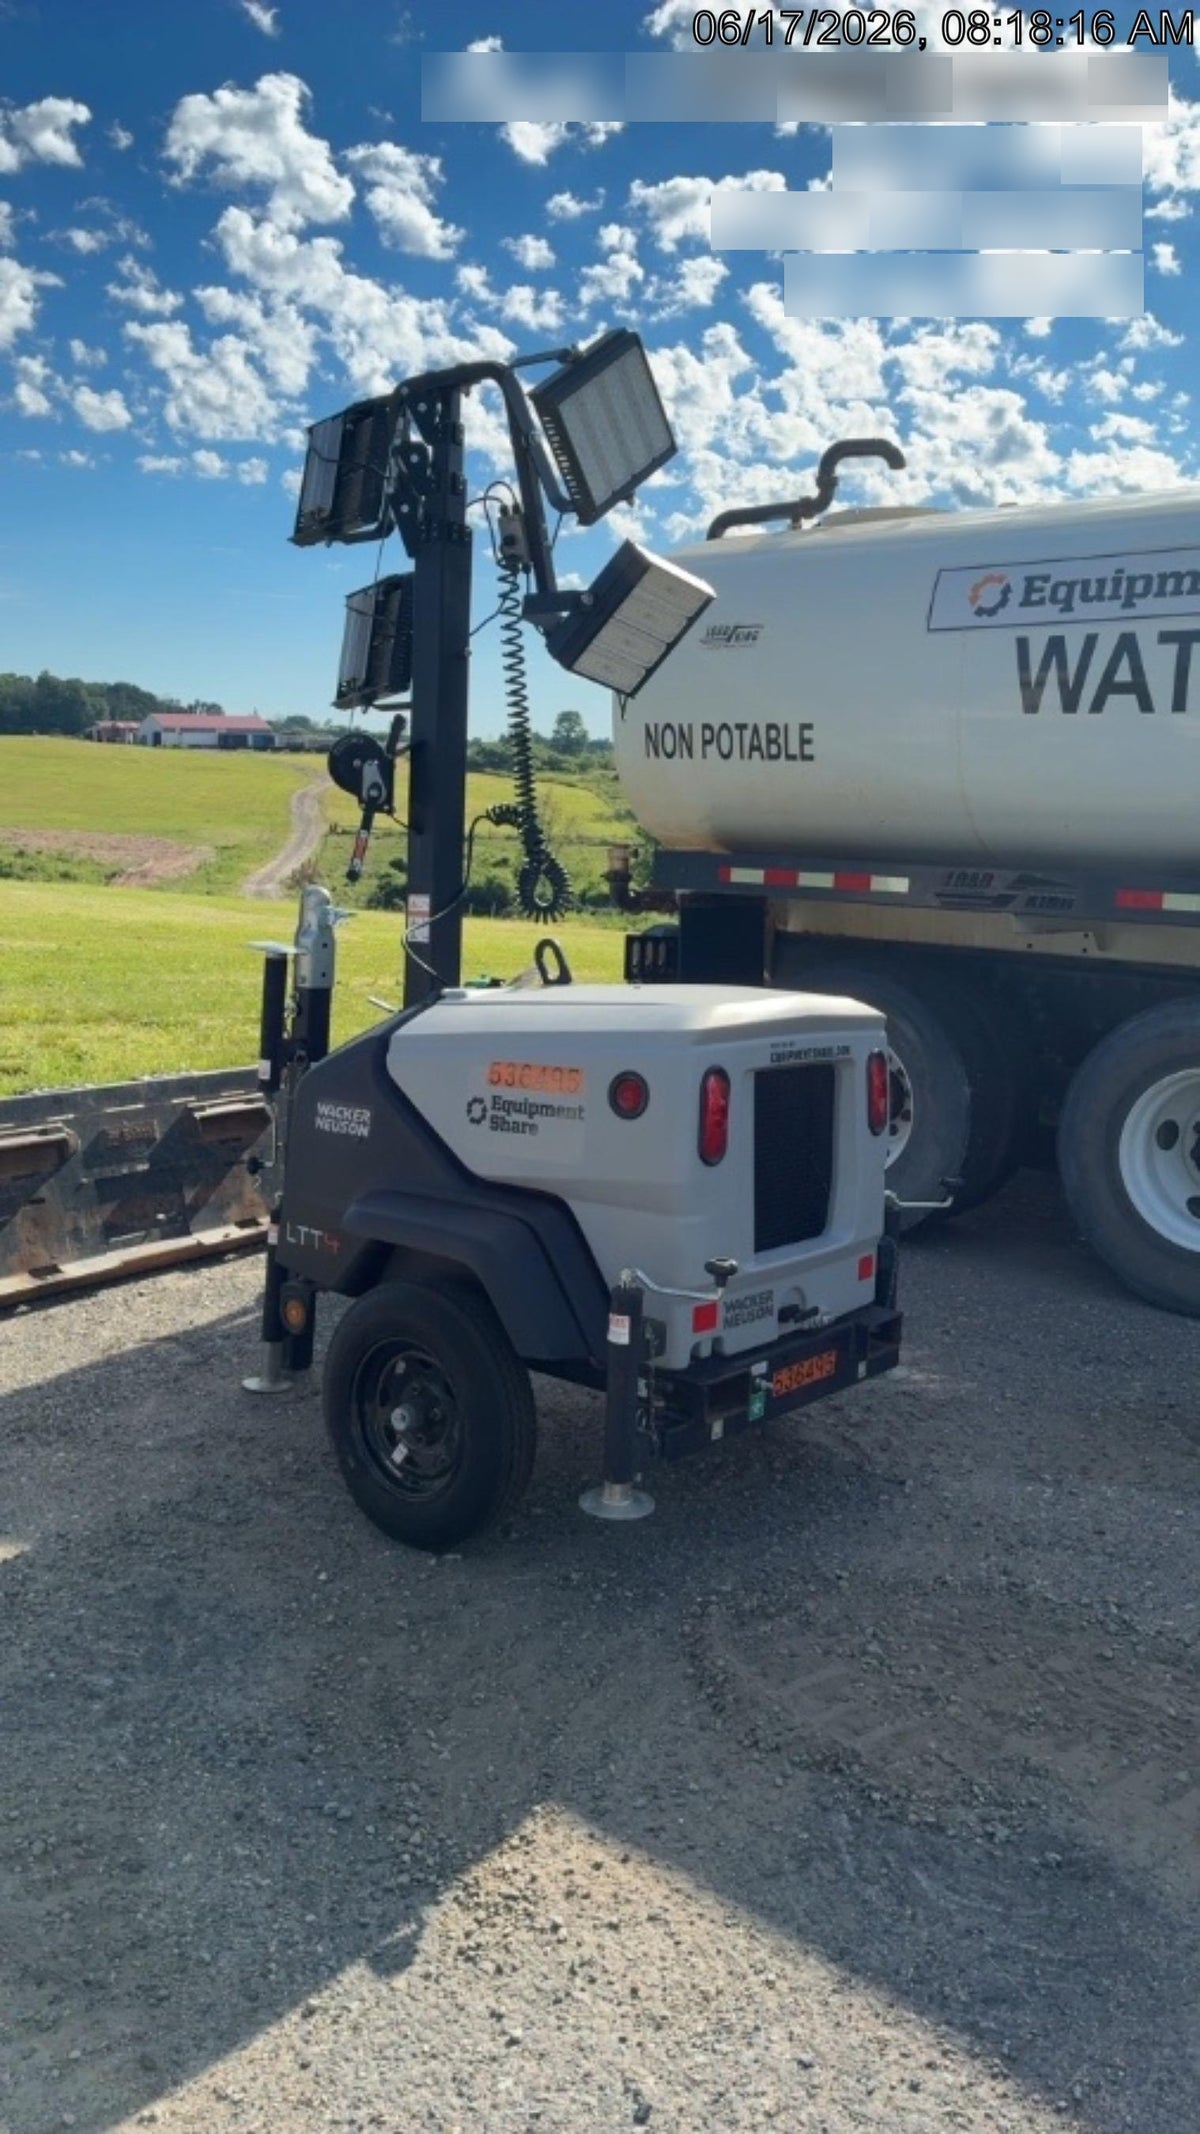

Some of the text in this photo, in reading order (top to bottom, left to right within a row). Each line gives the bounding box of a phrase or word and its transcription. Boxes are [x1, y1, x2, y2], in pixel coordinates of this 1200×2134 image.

[1018, 568, 1200, 613] Equipm
[1015, 629, 1200, 715] WAT
[644, 722, 815, 762] NON POTABLE
[316, 1101, 371, 1123] WACKER
[491, 1095, 585, 1121] Equipment
[314, 1115, 370, 1138] NEUSON
[489, 1115, 539, 1136] Share
[286, 1221, 342, 1253] LTT4
[723, 1289, 774, 1314] WACKER
[723, 1304, 774, 1330] NEUSON
